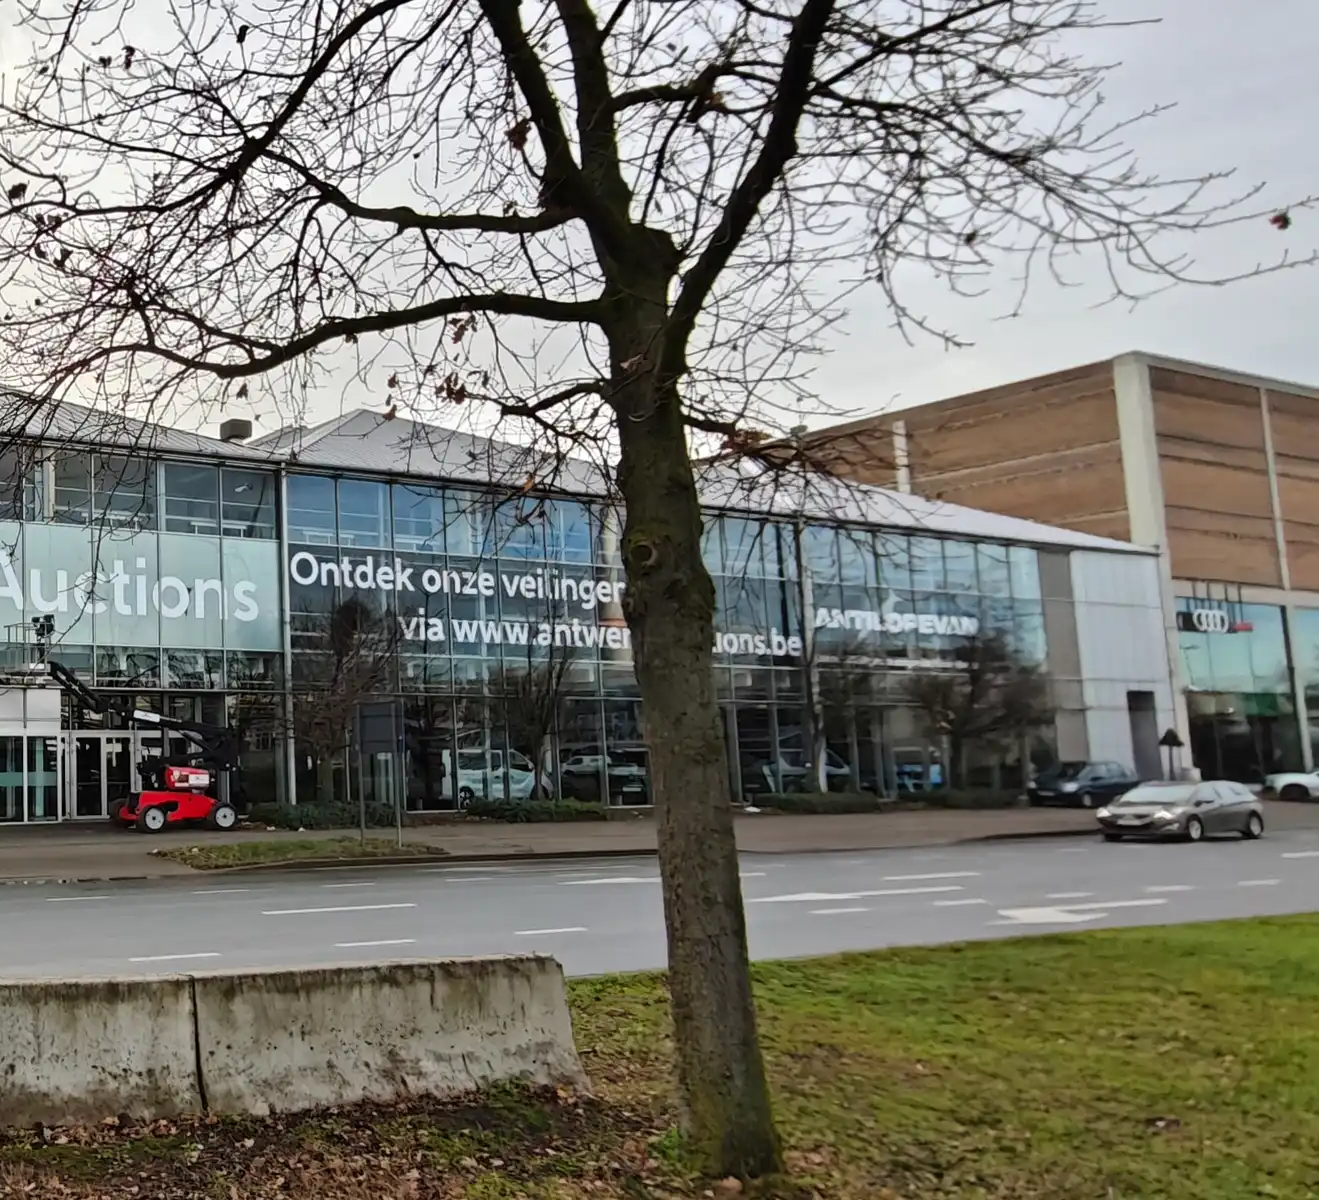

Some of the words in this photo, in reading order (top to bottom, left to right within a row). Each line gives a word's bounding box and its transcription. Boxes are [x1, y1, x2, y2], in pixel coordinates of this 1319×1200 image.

[290, 551, 415, 593] Ontdek
[422, 568, 495, 597] onze
[397, 607, 446, 642] via
